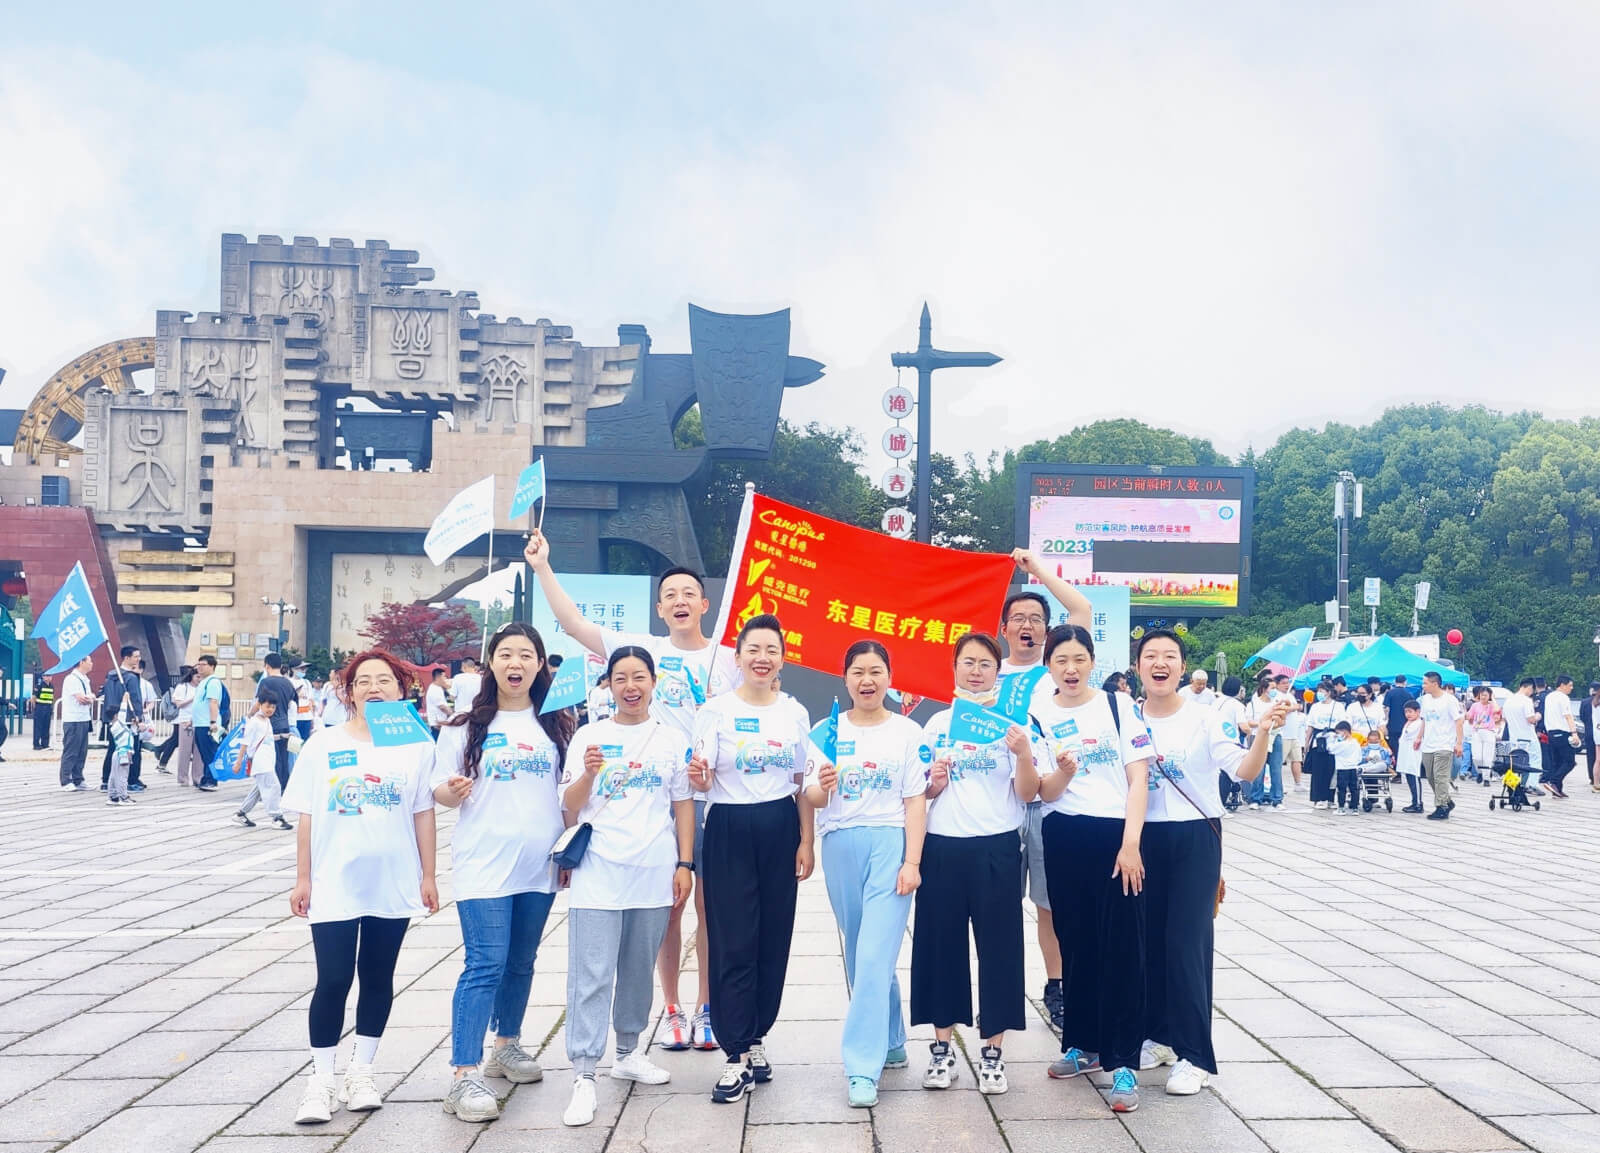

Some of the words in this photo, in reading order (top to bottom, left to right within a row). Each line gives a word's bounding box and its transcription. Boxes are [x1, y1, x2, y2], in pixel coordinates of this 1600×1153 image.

[759, 510, 825, 541] Canopus
[826, 599, 972, 645] 东星医疗集团
[960, 712, 1005, 734] Canopus
